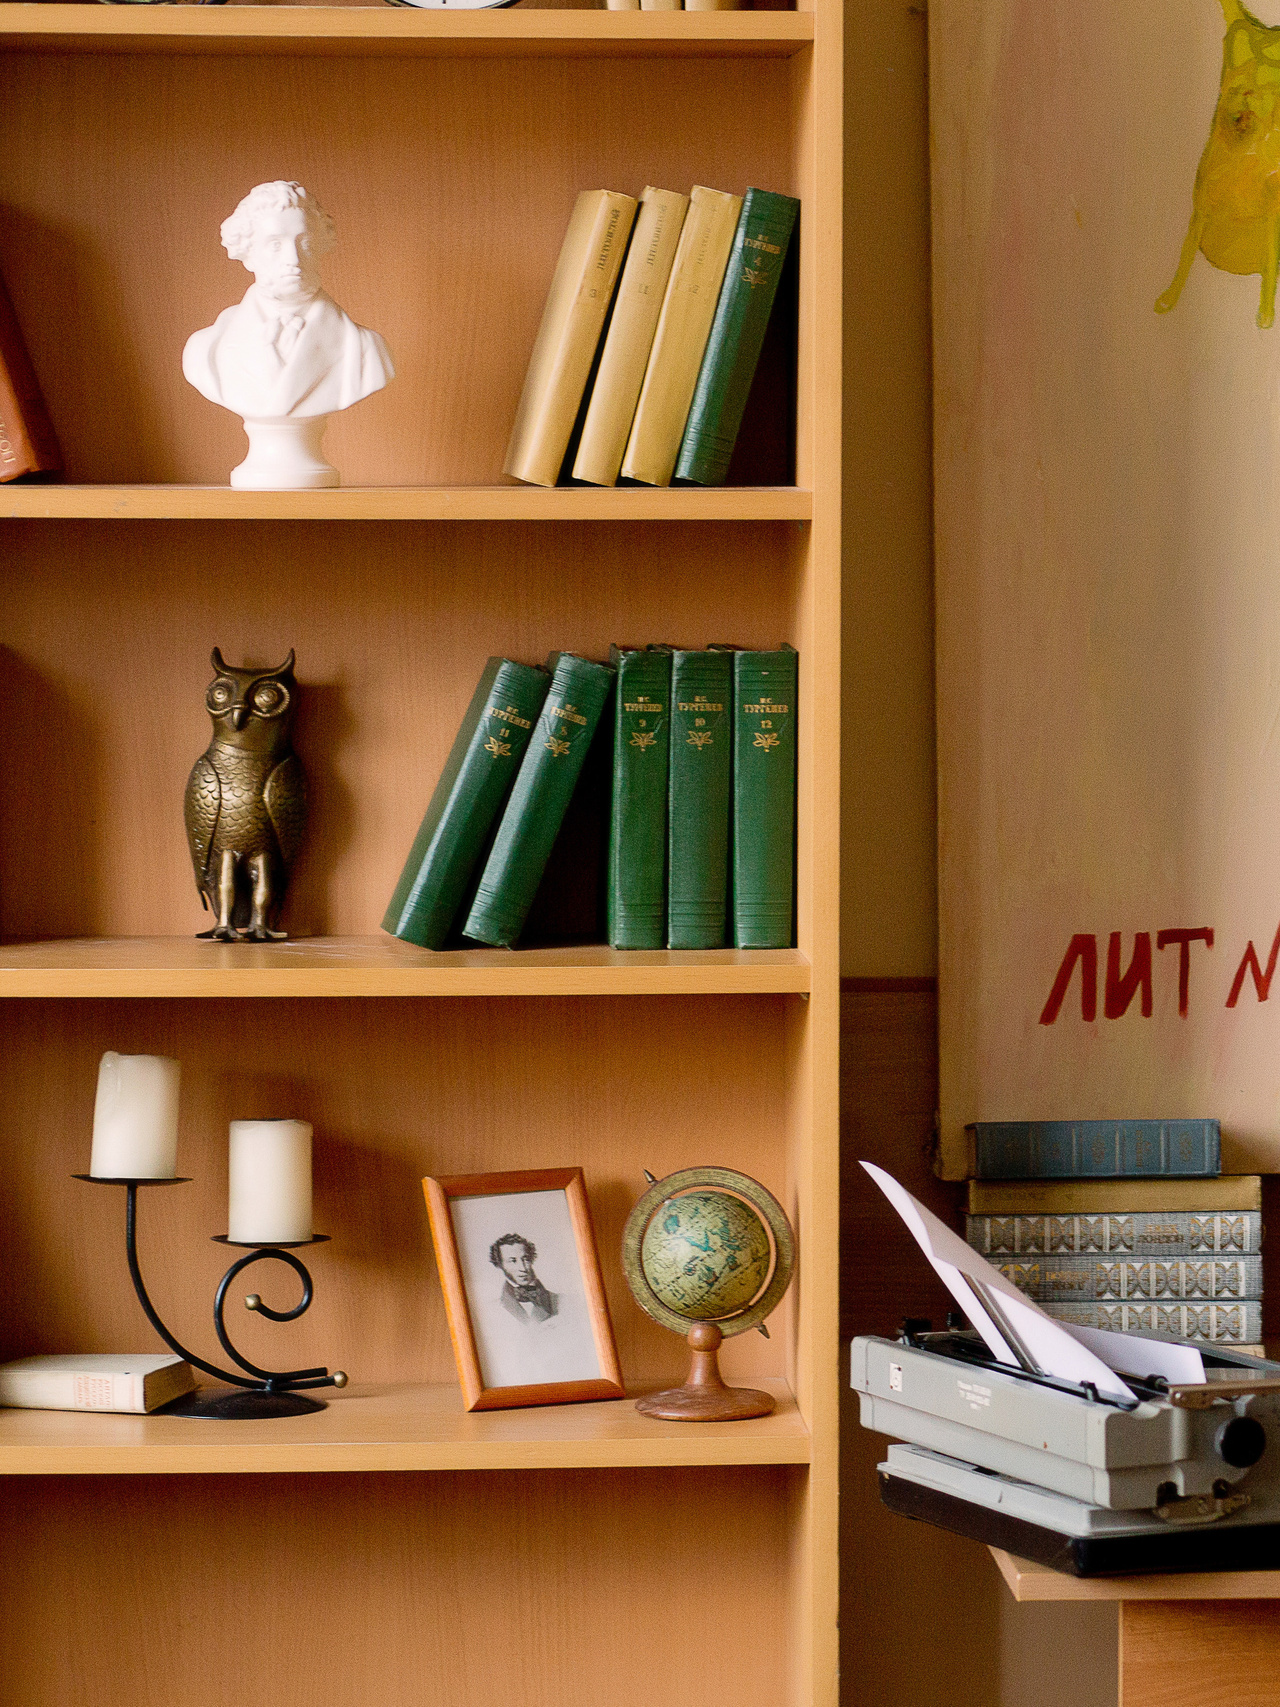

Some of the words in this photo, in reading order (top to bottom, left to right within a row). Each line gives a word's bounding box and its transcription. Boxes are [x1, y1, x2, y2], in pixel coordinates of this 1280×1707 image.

[678, 702, 723, 712] ТУРГЕНЕВ
[743, 704, 789, 713] ТУРГЕНЕВ
[489, 706, 531, 729] ТУРГЕНЕВ
[695, 718, 706, 727] 10
[638, 719, 647, 727] 9
[760, 719, 772, 729] 12
[499, 727, 510, 738] 11
[1038, 926, 1214, 1026] ЛИТ
